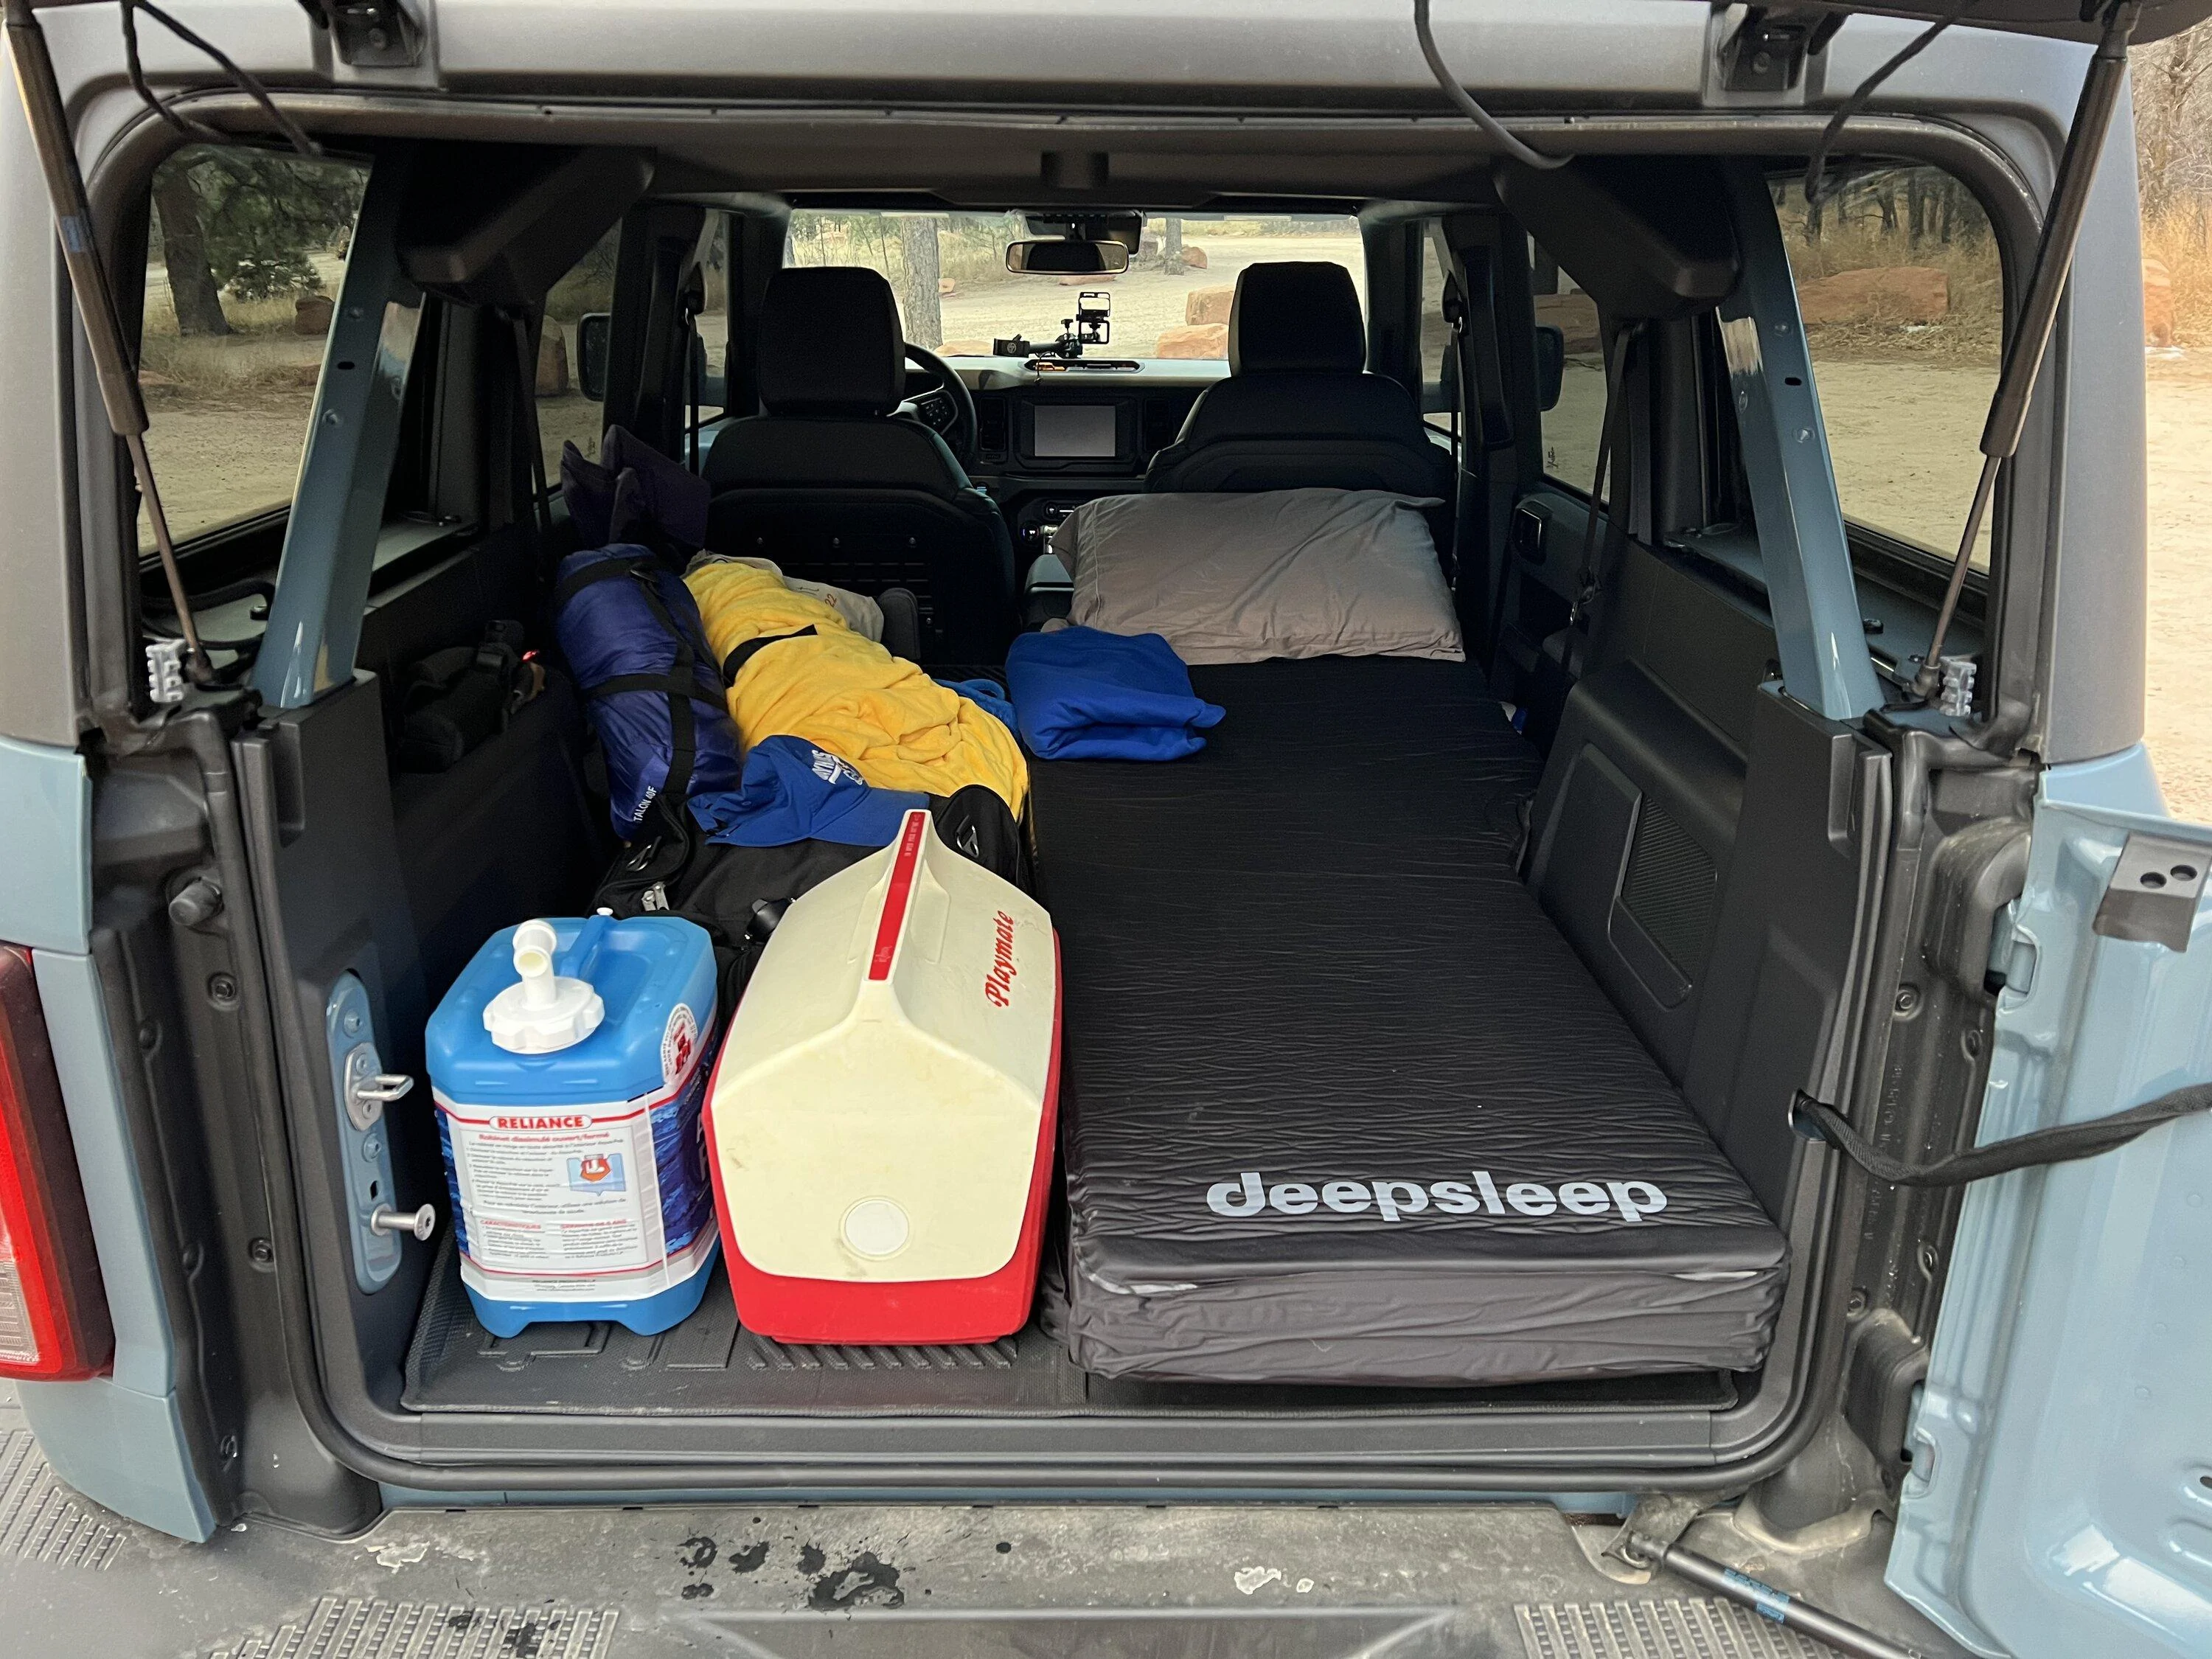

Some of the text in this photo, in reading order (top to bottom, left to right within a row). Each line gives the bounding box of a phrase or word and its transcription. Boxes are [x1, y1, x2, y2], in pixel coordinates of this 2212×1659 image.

[633, 786, 656, 821] TALON 40F
[985, 910, 1017, 1007] Playmate
[498, 1116, 584, 1129] RELIANCE
[1206, 1171, 1667, 1221] deepsleep
